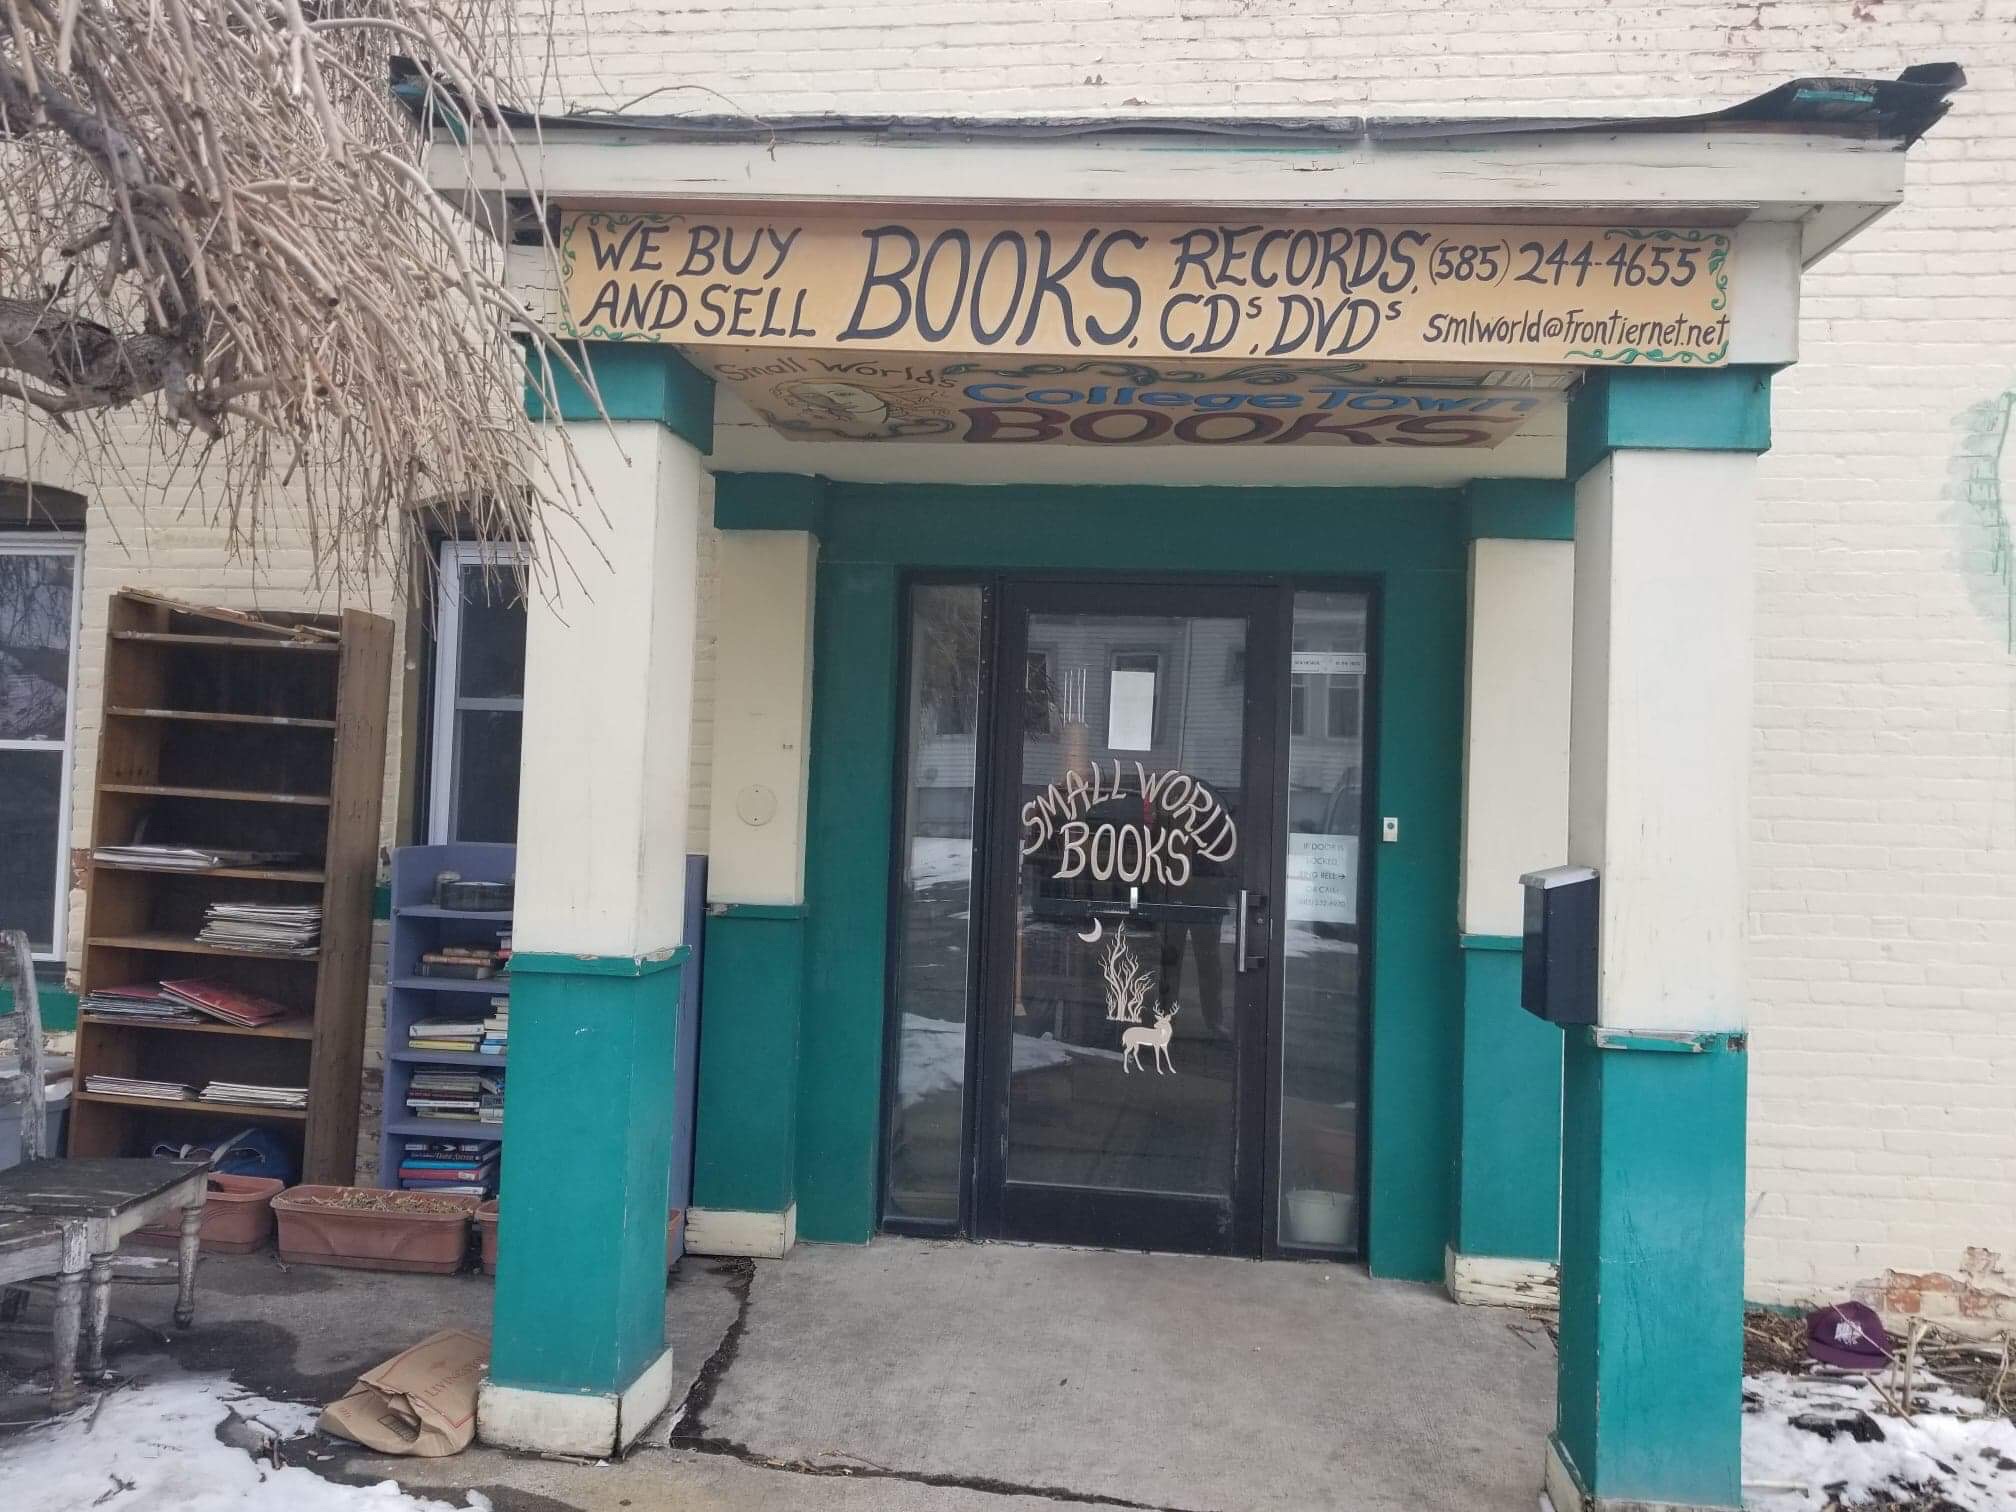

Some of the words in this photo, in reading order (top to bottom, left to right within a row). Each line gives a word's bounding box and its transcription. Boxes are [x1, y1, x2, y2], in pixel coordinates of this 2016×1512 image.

[587, 224, 670, 272] WE
[676, 224, 803, 279] BUY
[1429, 238, 1511, 288] (585)
[1514, 238, 1701, 288] 244-4655
[579, 279, 688, 332] AND
[694, 286, 816, 338] SELL
[714, 357, 806, 381] Small
[962, 383, 1303, 413] College
[1309, 386, 1541, 412] Town
[958, 407, 1526, 446] BOOKS
[1022, 758, 1127, 855] SMALL
[1134, 761, 1238, 863] WORLD
[1052, 821, 1190, 886] BOOKS
